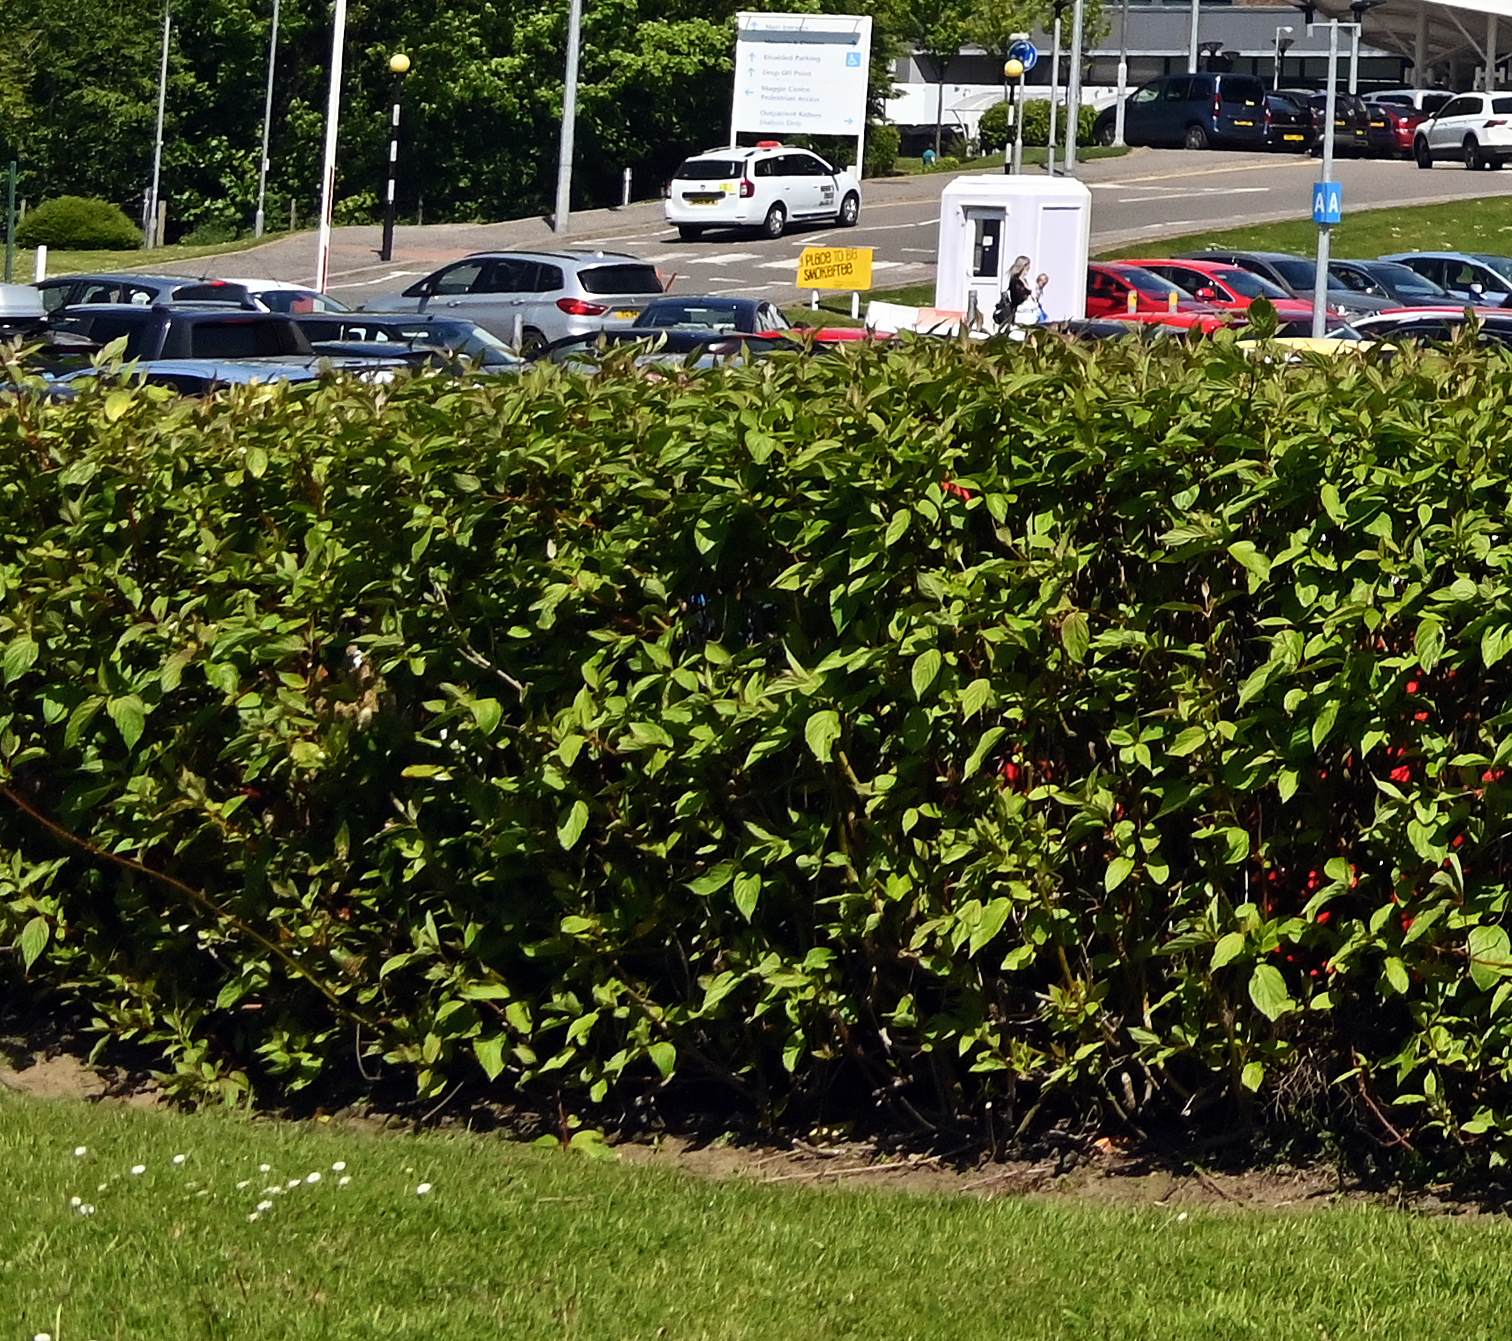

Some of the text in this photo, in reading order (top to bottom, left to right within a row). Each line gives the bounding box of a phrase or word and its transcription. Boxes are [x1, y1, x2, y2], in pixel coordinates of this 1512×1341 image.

[795, 55, 821, 63] Parking
[1314, 192, 1325, 213] A
[1328, 192, 1338, 213] A
